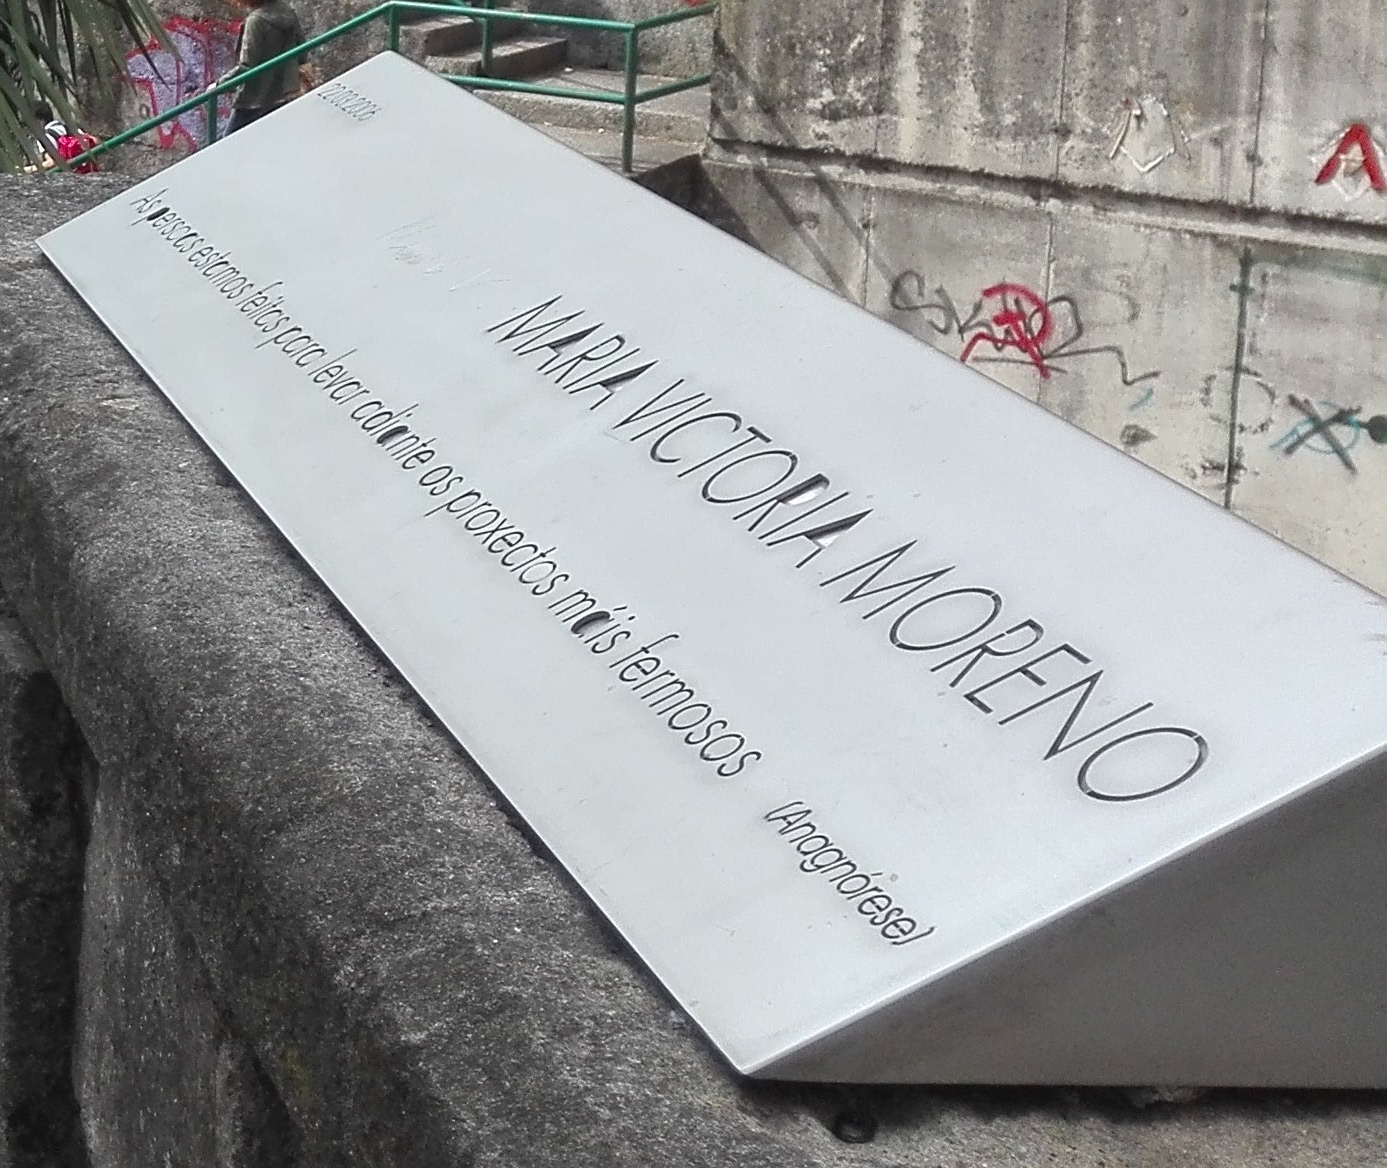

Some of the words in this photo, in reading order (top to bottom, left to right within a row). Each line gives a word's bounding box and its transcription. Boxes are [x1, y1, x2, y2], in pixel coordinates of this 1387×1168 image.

[129, 188, 170, 214] As
[131, 207, 205, 254] persoas
[187, 246, 254, 300] estamos
[235, 281, 291, 333] feitas
[255, 326, 326, 368] para
[307, 348, 371, 406] levar
[350, 399, 437, 470] adiante
[418, 465, 464, 496] os
[424, 489, 570, 597] proxectos
[487, 295, 659, 411] MARIA
[613, 379, 874, 569] VICTORIA
[819, 539, 1209, 803] MORENO
[547, 588, 637, 655] máis
[609, 633, 763, 777] fermosos
[763, 800, 936, 946] (Anagnórese)
